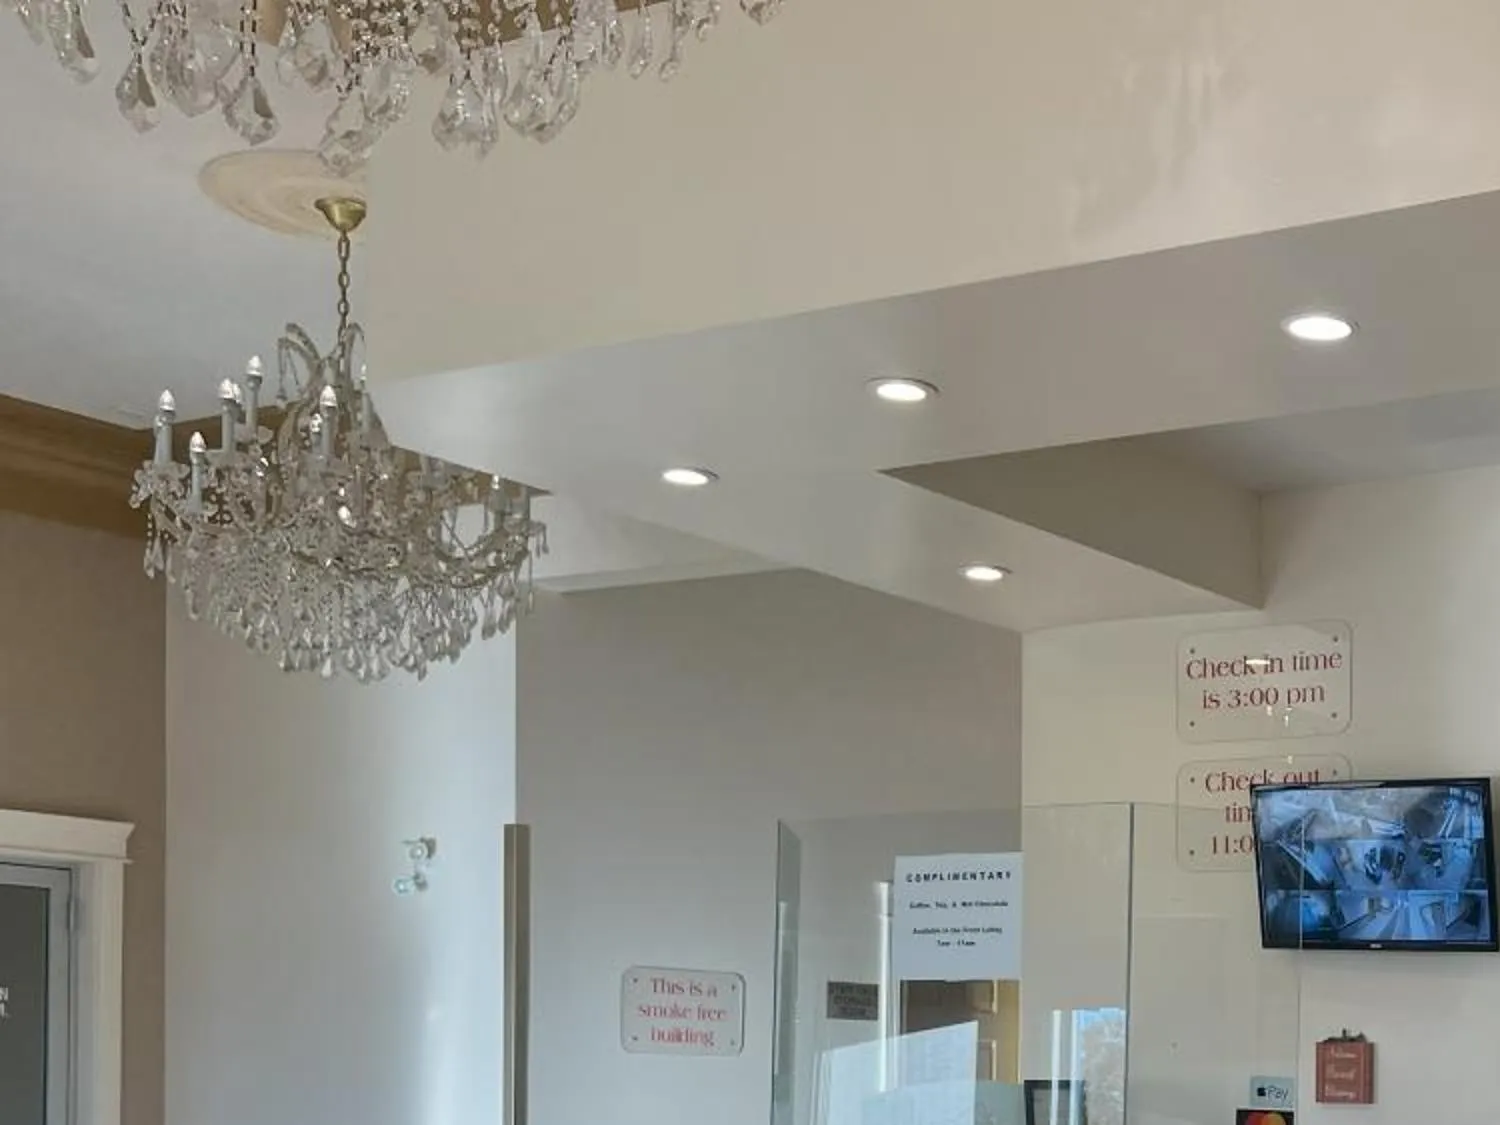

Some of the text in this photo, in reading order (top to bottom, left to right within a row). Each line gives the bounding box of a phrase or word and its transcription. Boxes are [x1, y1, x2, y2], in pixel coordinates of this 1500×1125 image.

[1186, 651, 1343, 680] Check in time
[1202, 684, 1326, 709] is 3:00 pm
[1205, 768, 1273, 793] Check
[1212, 834, 1254, 855] 11:0
[905, 871, 1011, 883] COMPLIMENTARY
[651, 977, 718, 998] This is a
[638, 1002, 728, 1021] smoke free
[650, 1025, 716, 1048] building
[1267, 1085, 1289, 1102] Pay
